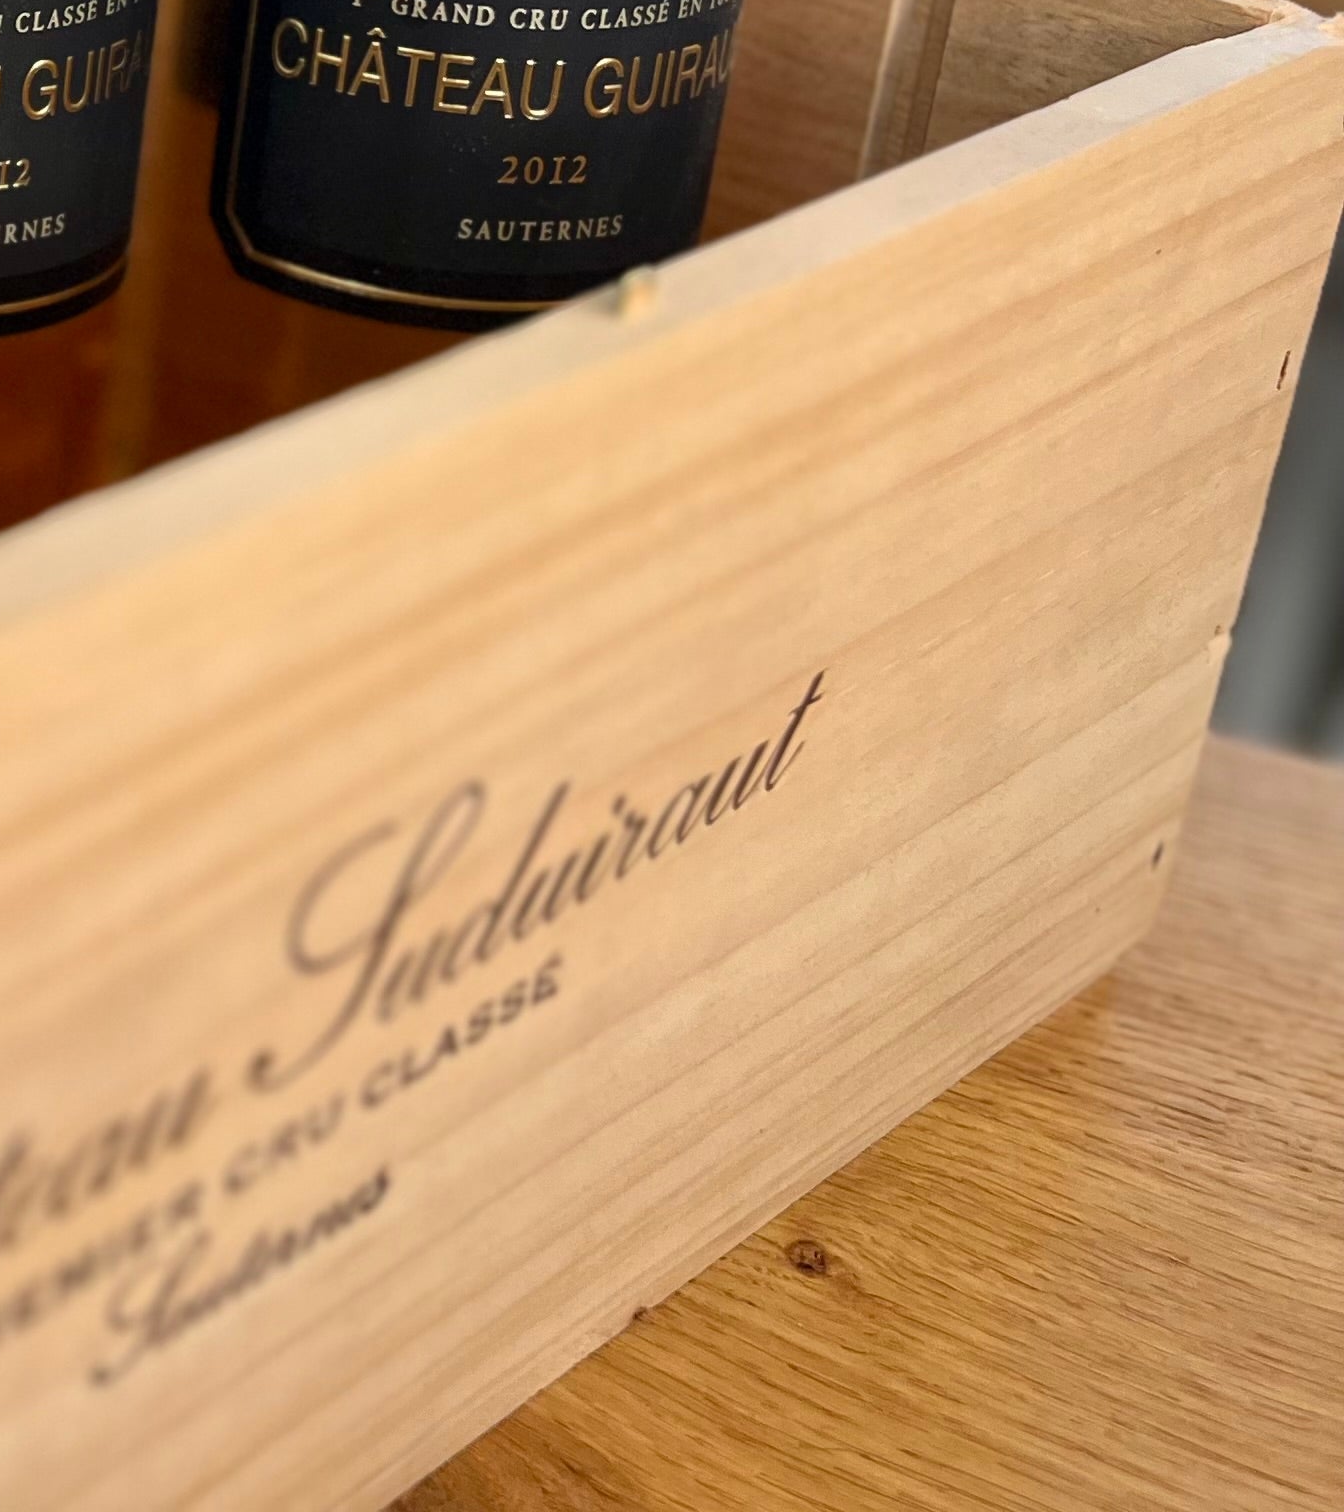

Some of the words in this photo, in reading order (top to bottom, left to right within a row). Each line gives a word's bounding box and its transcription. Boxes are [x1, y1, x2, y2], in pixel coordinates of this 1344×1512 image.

[509, 8, 569, 31] CRU
[270, 17, 567, 120] CHÂTEAU
[497, 155, 589, 186] 2012
[457, 215, 624, 242] SAUTERNES
[245, 666, 826, 1096] Suduiraut
